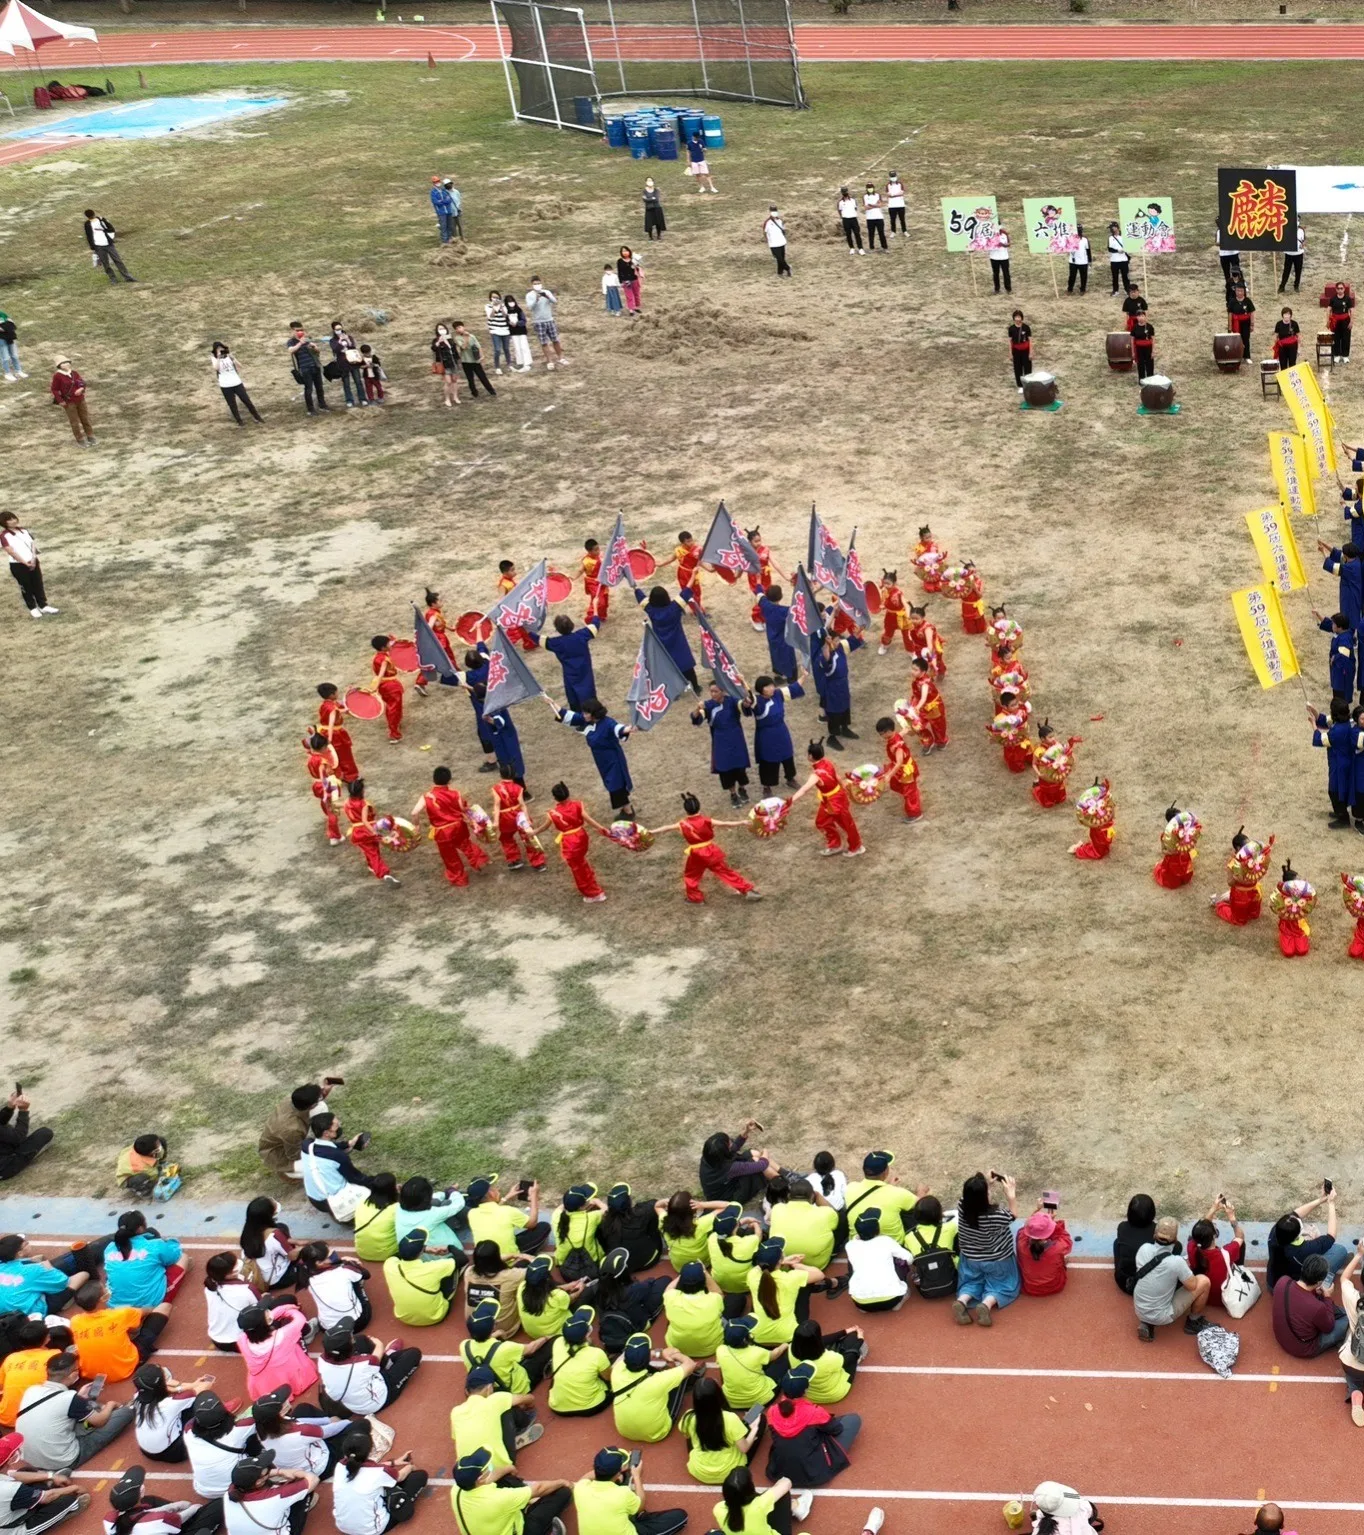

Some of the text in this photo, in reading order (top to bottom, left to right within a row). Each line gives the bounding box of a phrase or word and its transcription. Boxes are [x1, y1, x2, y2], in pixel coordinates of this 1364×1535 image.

[1033, 221, 1072, 238] 六堆
[1126, 221, 1170, 239] 運動會
[1228, 179, 1289, 242] 麟
[1260, 511, 1291, 592] 第59屆六堆運動會
[1248, 591, 1283, 682] 第59屆六堆運動會
